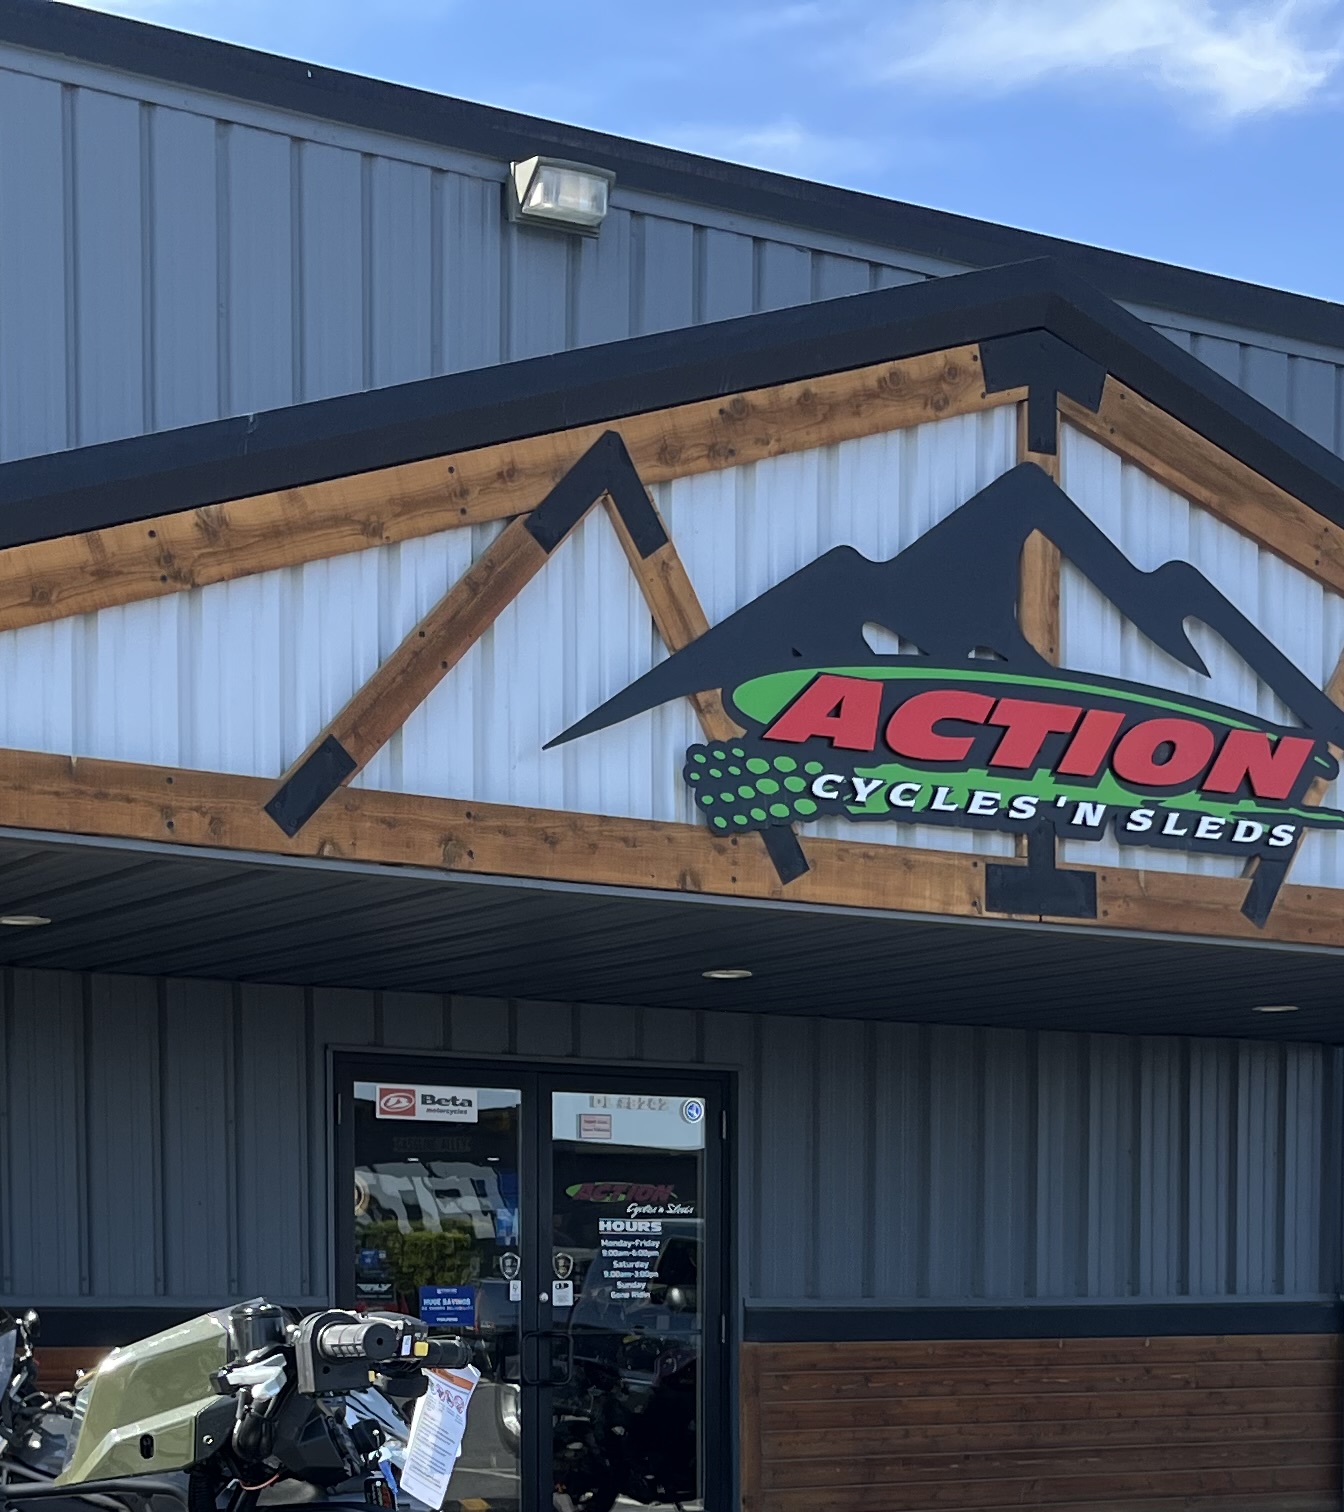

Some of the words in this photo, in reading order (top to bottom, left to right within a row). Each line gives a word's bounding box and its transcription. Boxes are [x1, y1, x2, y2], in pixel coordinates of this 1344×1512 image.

[763, 673, 1316, 801] ACTION
[1125, 807, 1296, 847] SLEDS
[421, 1093, 473, 1108] Beta
[573, 1183, 674, 1202] ACTION
[599, 1221, 662, 1232] HOURS
[612, 1260, 649, 1269] Saturday
[616, 1281, 646, 1289] Sunday
